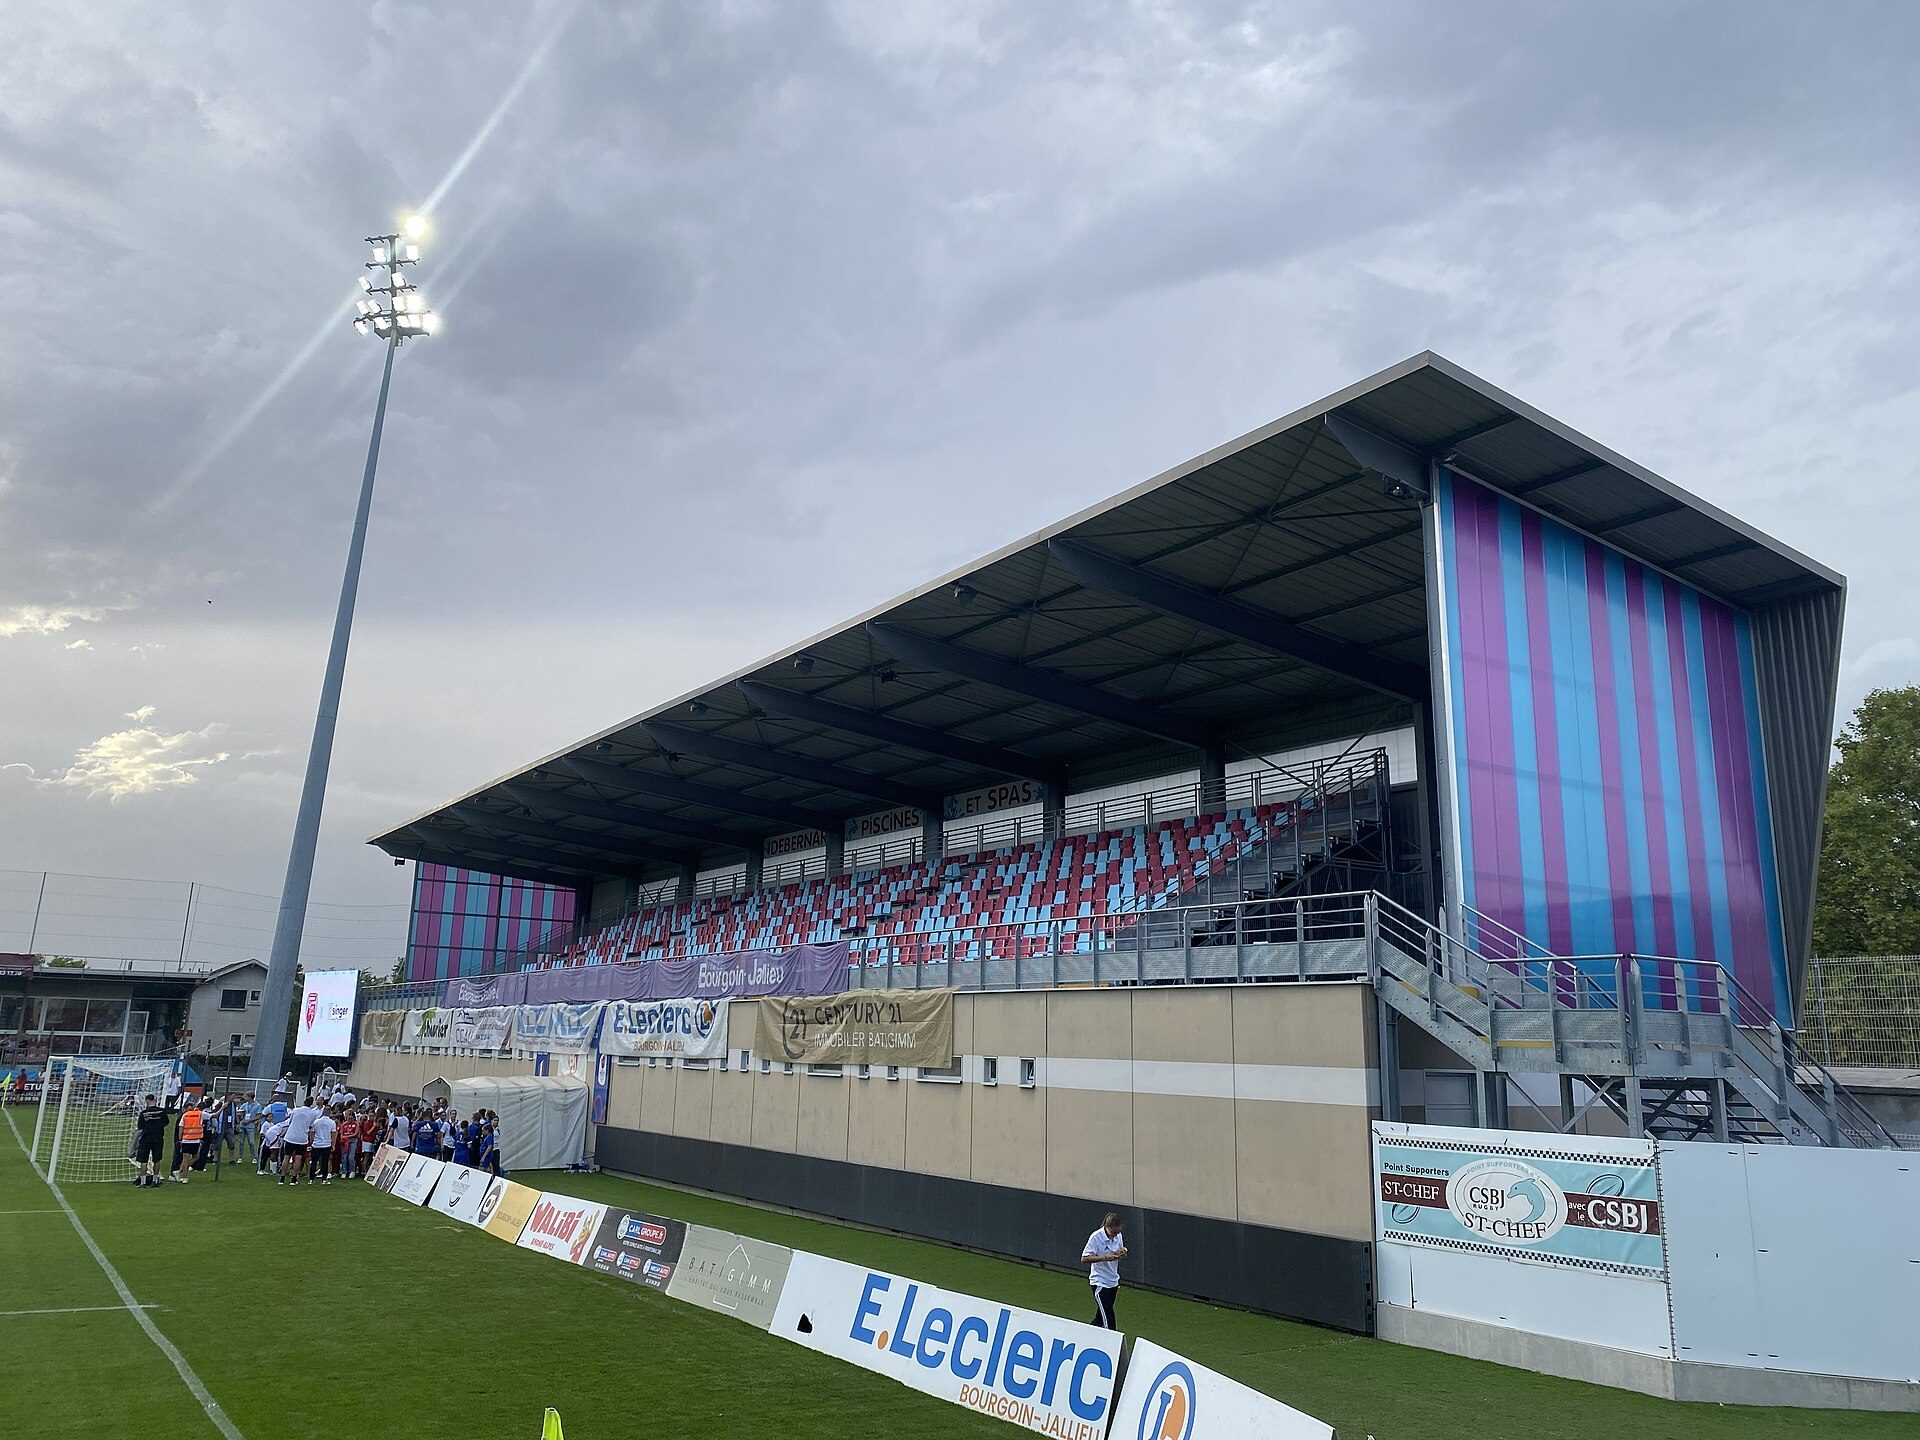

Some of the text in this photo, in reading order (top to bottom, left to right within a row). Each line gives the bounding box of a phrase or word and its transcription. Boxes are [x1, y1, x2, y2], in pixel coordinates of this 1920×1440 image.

[966, 781, 1032, 813] ET SPAS
[814, 1002, 902, 1025] CENTURY 21
[868, 1032, 917, 1049] BATIGIMM
[1384, 1162, 1450, 1176] Point Supporters
[1466, 1163, 1486, 1175] POINT
[1487, 1161, 1529, 1174] SUPPORTERS
[1384, 1180, 1440, 1200] ST-CHEF
[1469, 1186, 1505, 1209] CSBJ
[1568, 1202, 1586, 1210] avec
[1577, 1212, 1585, 1220] le
[1587, 1199, 1648, 1233] CSBJ
[1464, 1212, 1546, 1239] ST-CHEF
[688, 1257, 772, 1293] BATIGIMM
[849, 1272, 1113, 1422] E.Leclerc
[958, 1383, 1101, 1440] BOURGOIN-JALLIEU
